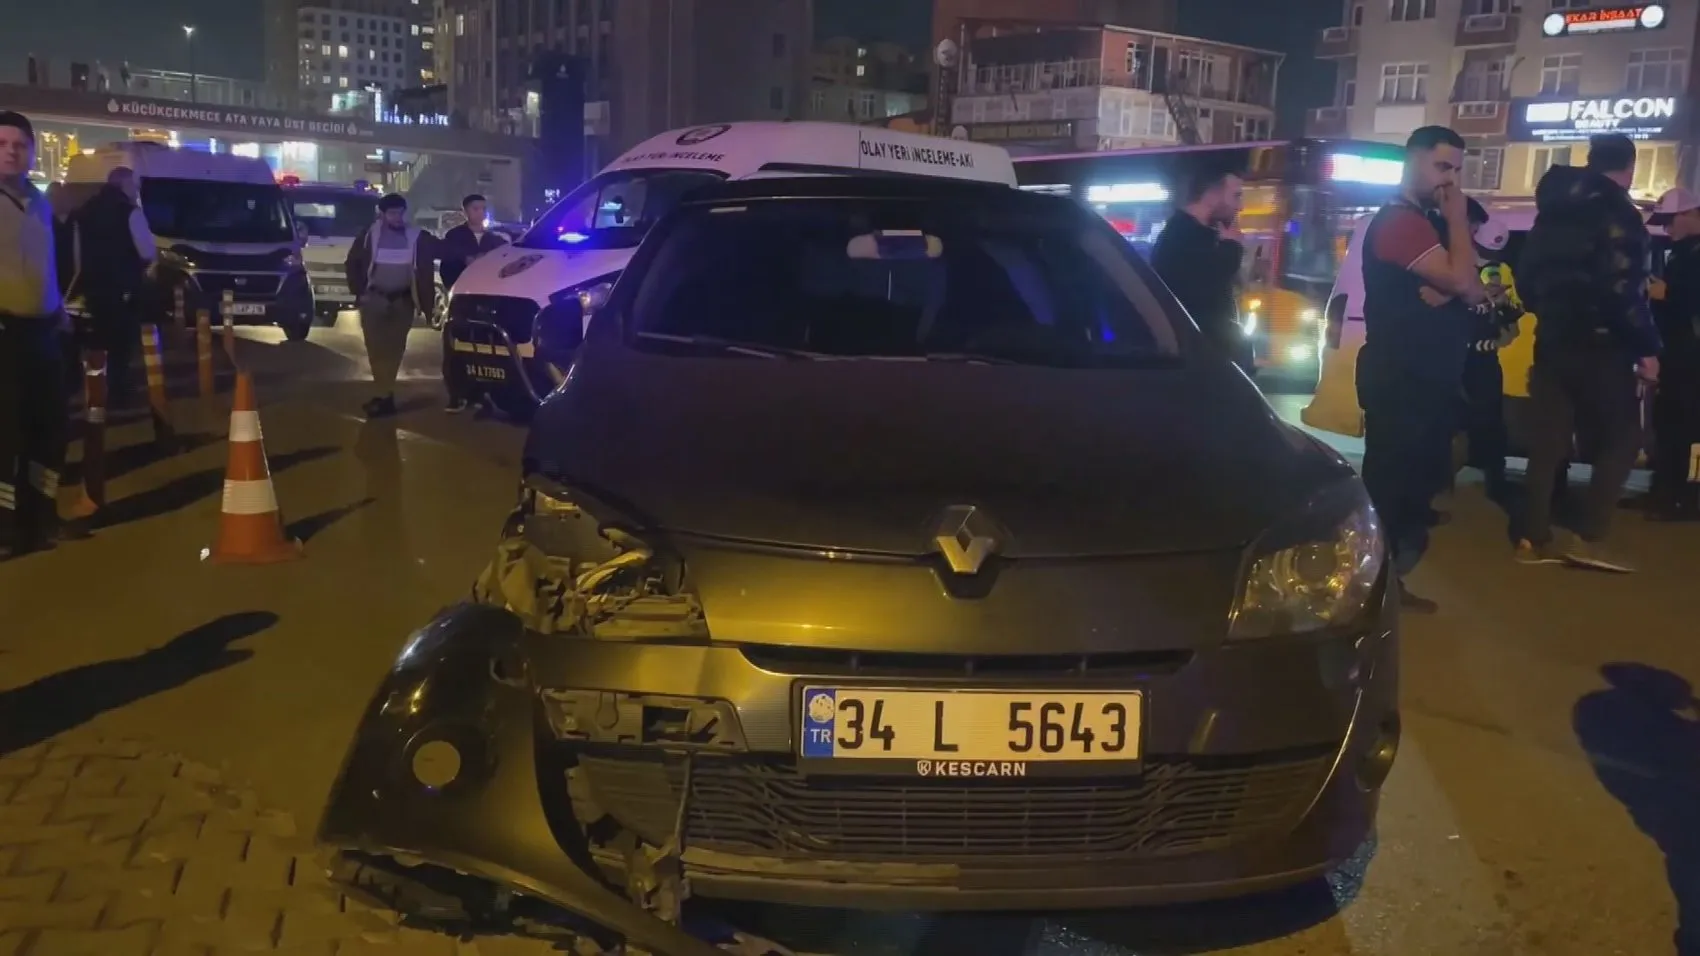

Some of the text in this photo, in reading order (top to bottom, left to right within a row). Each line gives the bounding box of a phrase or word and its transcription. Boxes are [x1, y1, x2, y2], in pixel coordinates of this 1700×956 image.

[1570, 97, 1675, 120] FALCON
[225, 112, 247, 124] ATA
[251, 115, 280, 128] YAYA
[861, 140, 886, 158] OLAY
[810, 699, 1127, 753] TR 34 L 5643
[935, 762, 1027, 777] KESCARN
